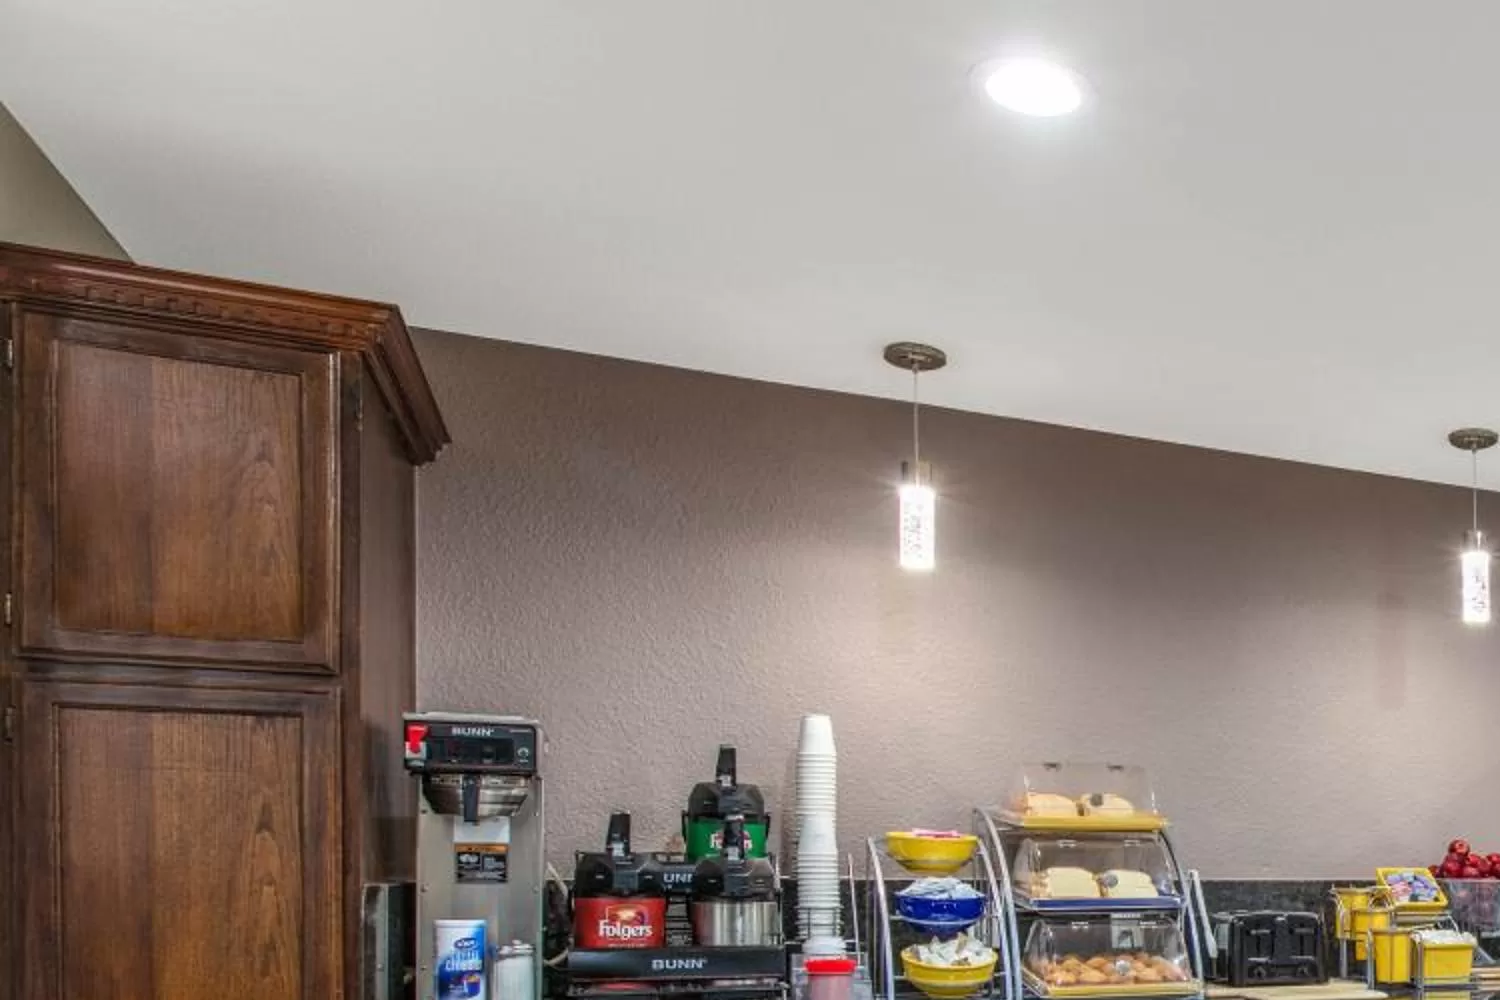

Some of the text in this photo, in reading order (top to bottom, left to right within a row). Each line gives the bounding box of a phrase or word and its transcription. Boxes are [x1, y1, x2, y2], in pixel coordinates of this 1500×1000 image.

[451, 727, 491, 736] BUNN
[599, 919, 653, 940] Folgers
[652, 958, 704, 971] BUNN
